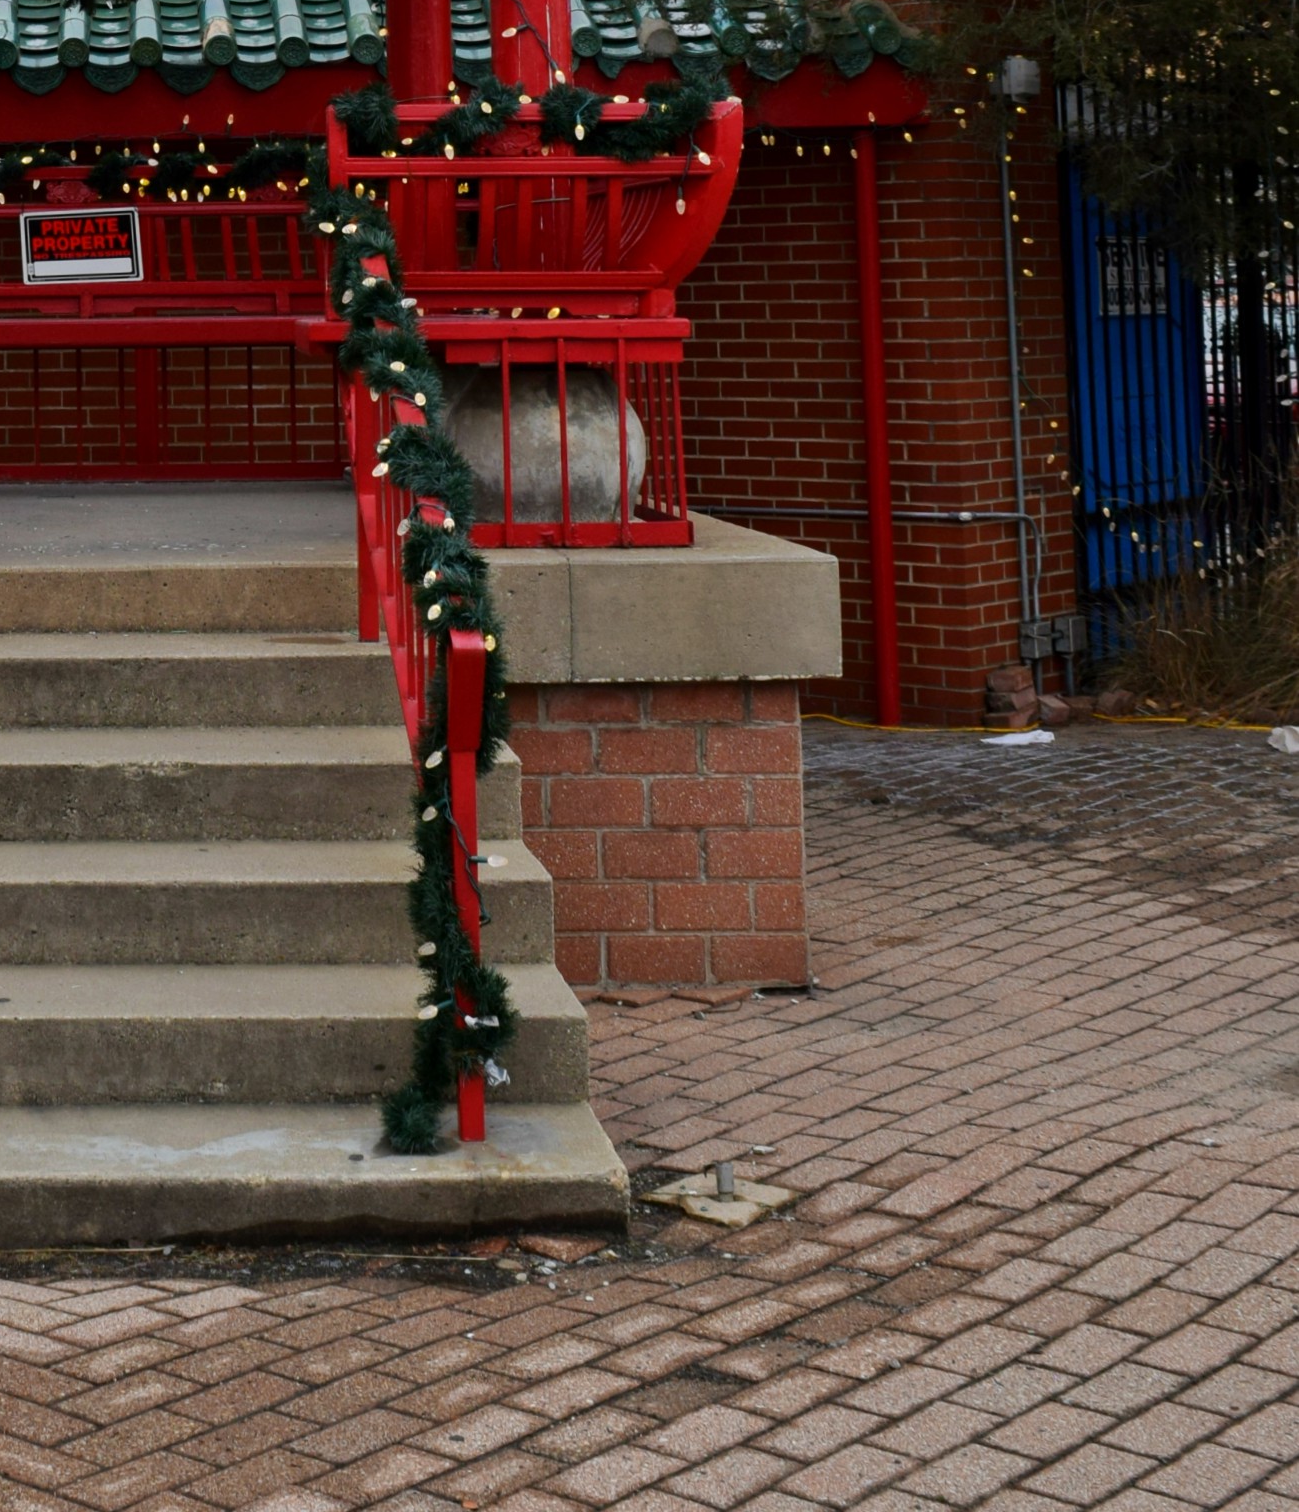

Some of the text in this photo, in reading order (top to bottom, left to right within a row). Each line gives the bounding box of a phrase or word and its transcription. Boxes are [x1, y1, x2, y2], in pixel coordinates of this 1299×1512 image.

[41, 218, 119, 235] PRIVATE
[32, 234, 129, 251] PROPERTY
[53, 250, 131, 259] TRESPASSING
